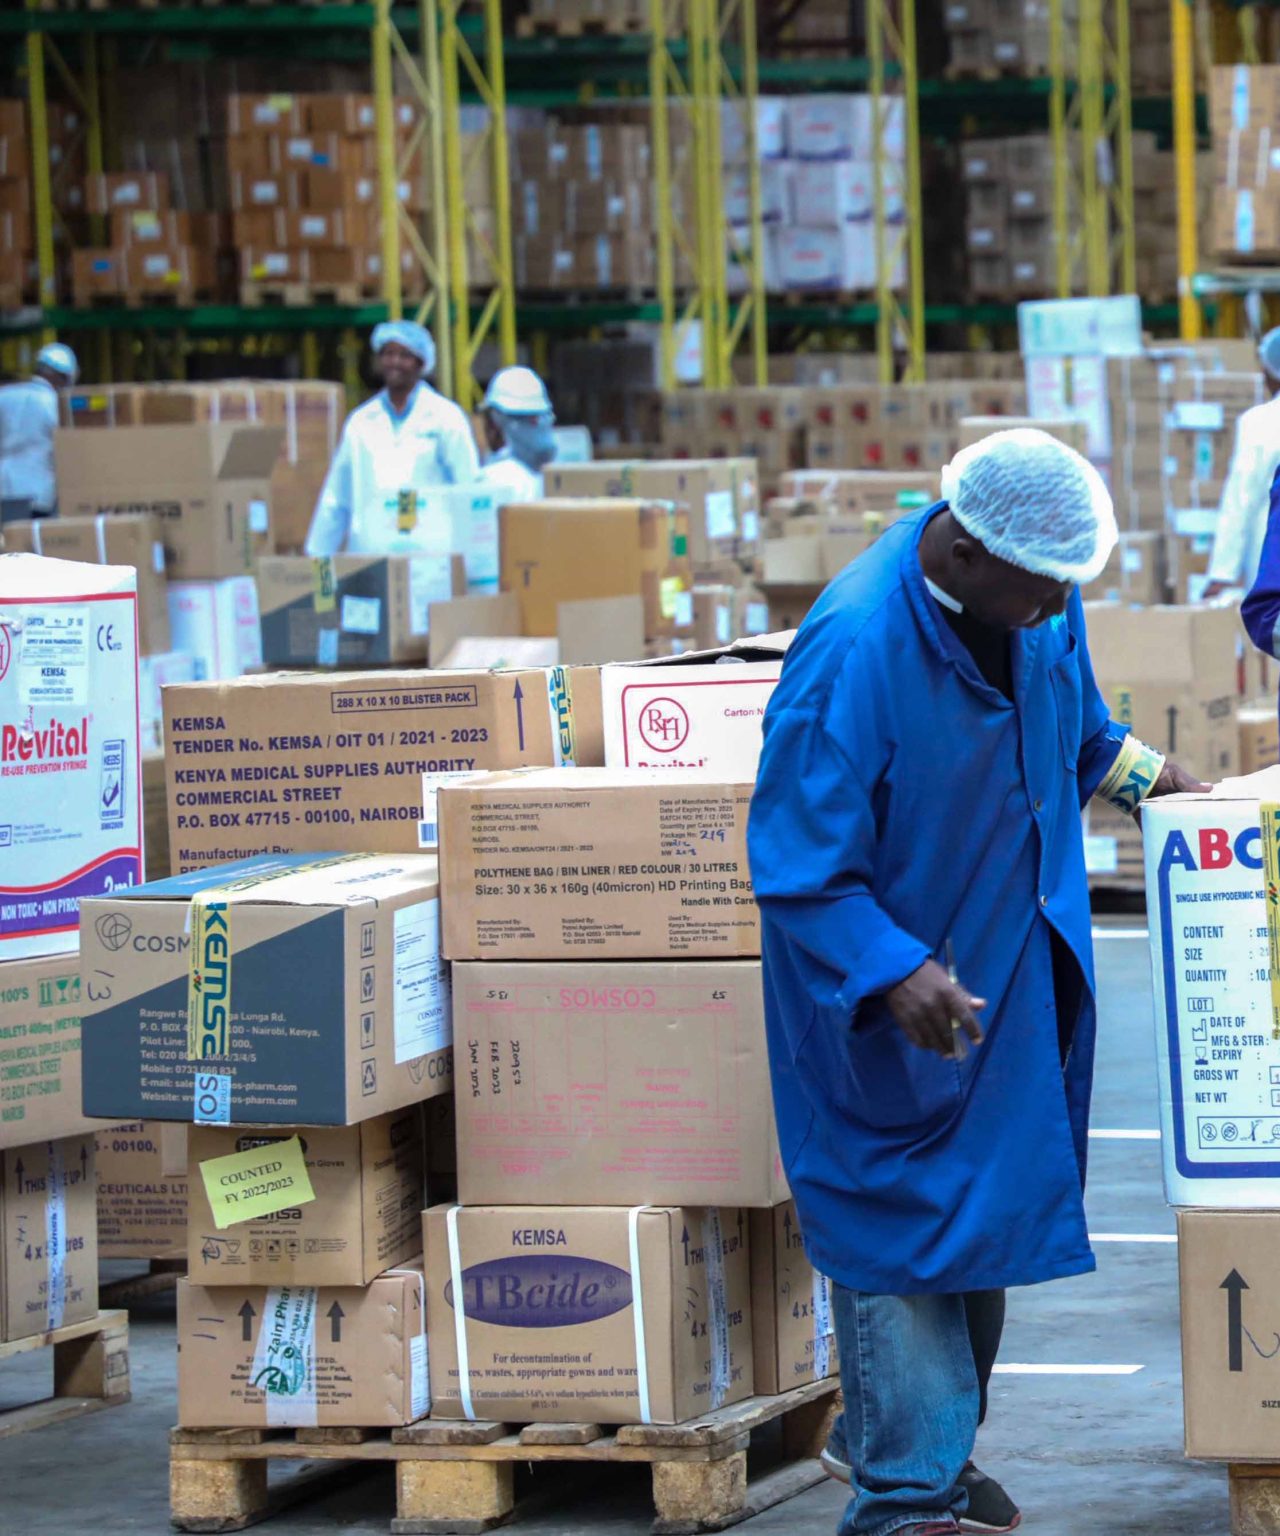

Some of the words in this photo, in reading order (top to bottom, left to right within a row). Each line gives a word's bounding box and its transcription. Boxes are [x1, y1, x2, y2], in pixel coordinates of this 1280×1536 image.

[724, 708, 754, 718] Carton
[172, 717, 226, 731] KEMSA
[173, 739, 235, 754] TENDER
[239, 738, 264, 751] No.
[268, 735, 322, 751] KEMSA
[335, 733, 363, 748] OIT
[367, 732, 385, 747] 01
[399, 730, 436, 746] 2021
[450, 728, 489, 743] 2023
[1, 762, 24, 776] RE-USE
[25, 761, 61, 775] PREVENTION
[62, 759, 87, 773] SYRINGE
[175, 769, 227, 783] KENYA
[231, 766, 299, 781] MEDICAL
[304, 763, 379, 779] SUPPLIES
[385, 758, 476, 776] AUTHORITY
[176, 790, 278, 806] COMMERCIAL
[283, 787, 342, 803] STREET
[178, 814, 205, 828] P.O.
[210, 812, 241, 827] BOX
[245, 810, 291, 826] 47715
[304, 809, 355, 825] 00100,
[360, 806, 425, 822] NAIROBI
[474, 867, 532, 878] POLYTHENE
[533, 866, 554, 877] BAG
[561, 866, 579, 877] BIN
[581, 865, 611, 876] LINER
[618, 865, 639, 876] RED
[641, 863, 682, 875] COLOUR
[689, 863, 701, 873] 30
[703, 862, 738, 873] LITRES
[475, 884, 503, 896] Size:
[507, 883, 521, 895] 30
[524, 885, 531, 895] x
[533, 882, 548, 895] 36
[550, 885, 558, 894] x
[562, 882, 589, 896] 160g
[592, 880, 656, 896] (40micron)
[659, 880, 676, 891] HD
[680, 879, 727, 892] Printing
[681, 897, 711, 906] Handle
[713, 896, 732, 906] With
[1199, 892, 1212, 903] USE
[1212, 890, 1254, 902] HYPODERMIC
[1183, 925, 1225, 939] CONTENT
[133, 937, 191, 953] COSM
[1184, 947, 1203, 961] SIZE
[1185, 969, 1227, 982] QUANTITY
[1192, 999, 1209, 1011] LOT
[1210, 1016, 1233, 1028] DATE
[1235, 1016, 1246, 1027] OF
[1212, 1048, 1242, 1061] EXPIRY
[1193, 1069, 1223, 1081] GROSS
[1226, 1069, 1239, 1080] WT
[1195, 1091, 1212, 1104] NET
[1214, 1091, 1228, 1103] WT
[112, 1138, 158, 1156] 00100,
[219, 1160, 283, 1187] COUNTED
[225, 1191, 239, 1206] FY
[242, 1176, 295, 1201] 2022/2023
[512, 1229, 568, 1247] KEMSA
[464, 1272, 601, 1312] TBcide
[274, 1286, 291, 1320] Phar
[267, 1322, 286, 1355] Zain
[493, 1353, 507, 1364] For
[509, 1352, 576, 1364] decontamination
[579, 1351, 592, 1364] of
